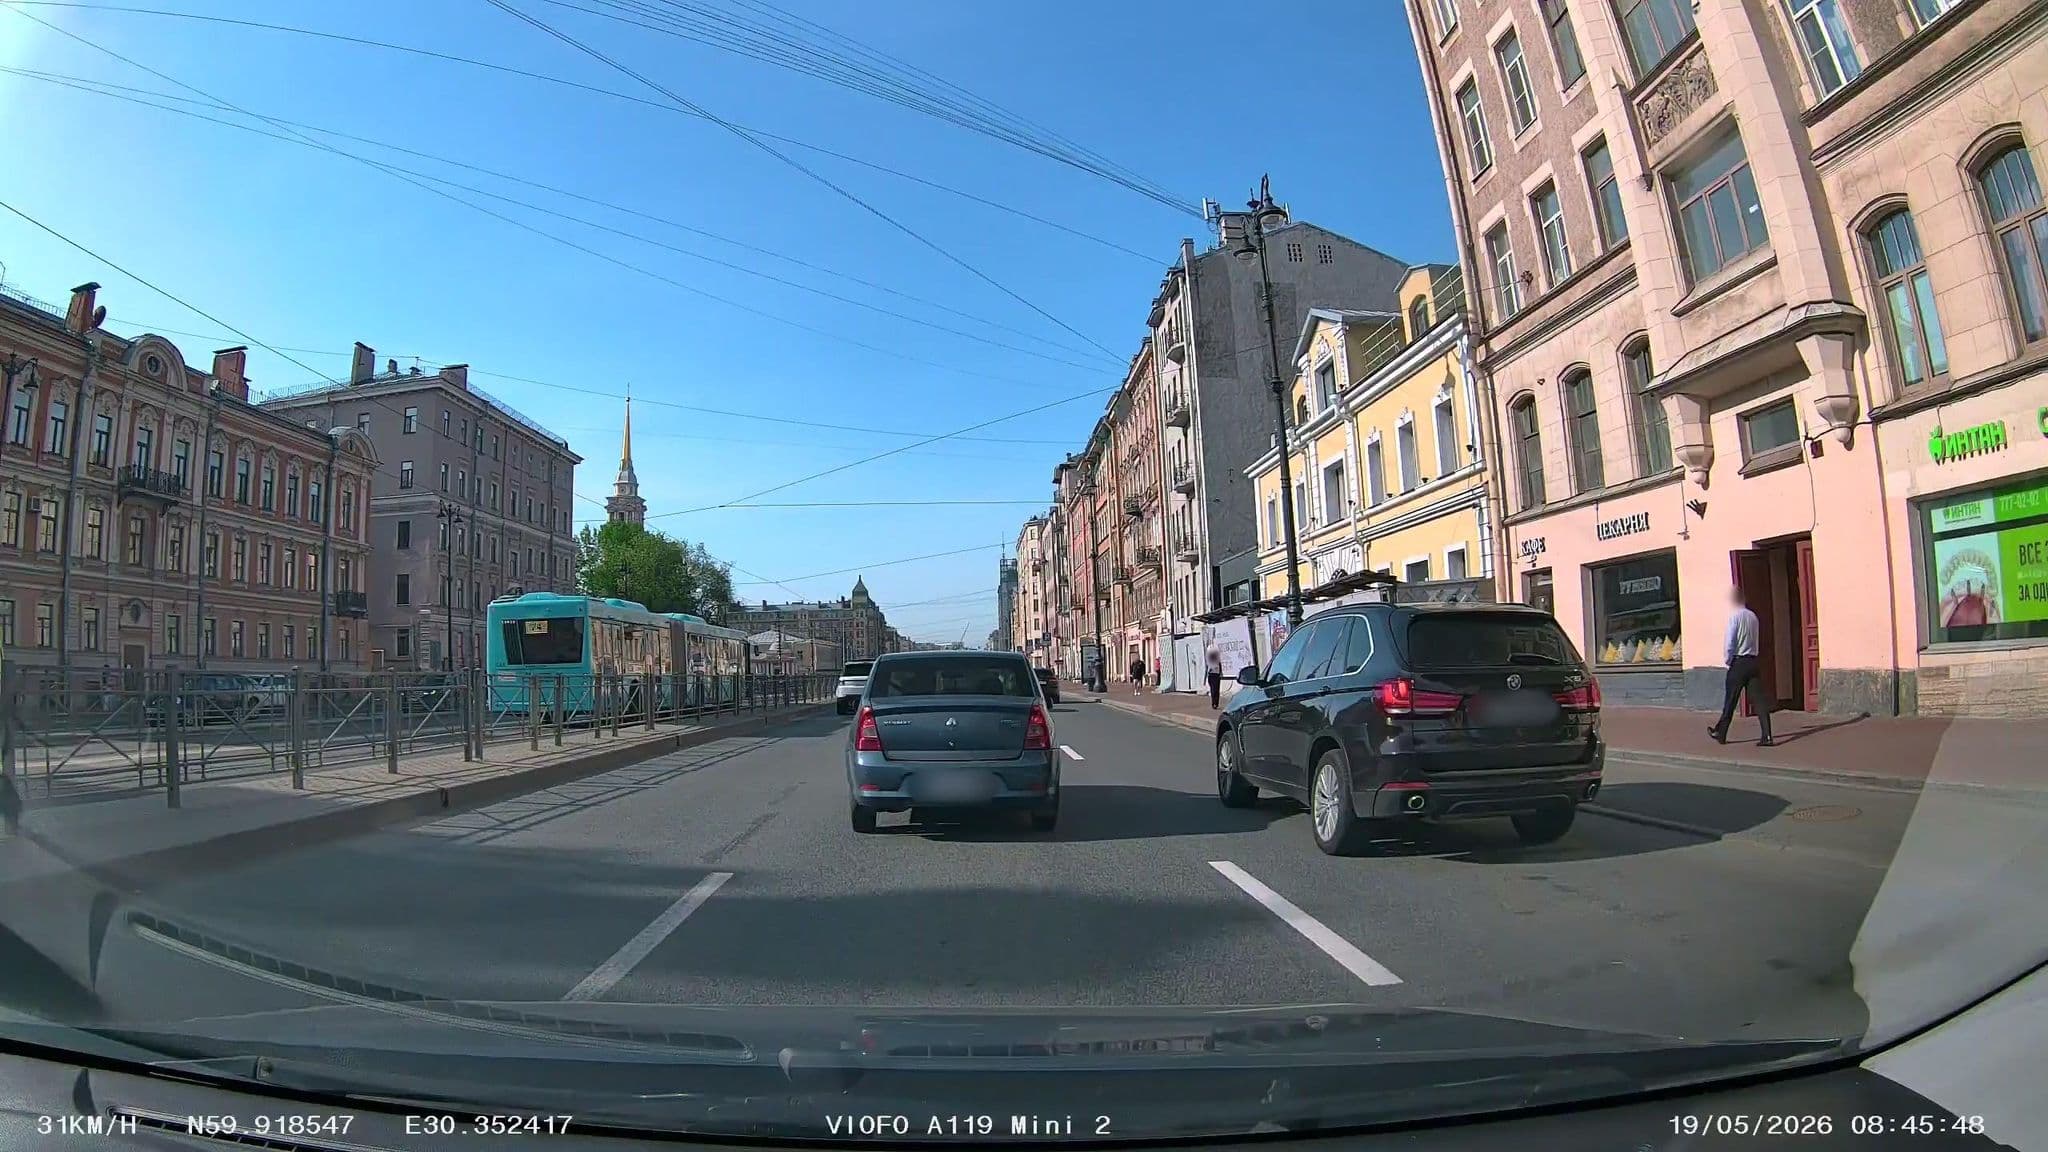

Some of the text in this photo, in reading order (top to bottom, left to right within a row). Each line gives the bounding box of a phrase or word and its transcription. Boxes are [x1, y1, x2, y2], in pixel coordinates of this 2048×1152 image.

[1945, 420, 2007, 460] ИНТАН
[1597, 512, 1649, 541] ПЕКАРНЯ
[2019, 541, 2042, 566] ВСЕ
[2018, 582, 2048, 602] ЗА ОД
